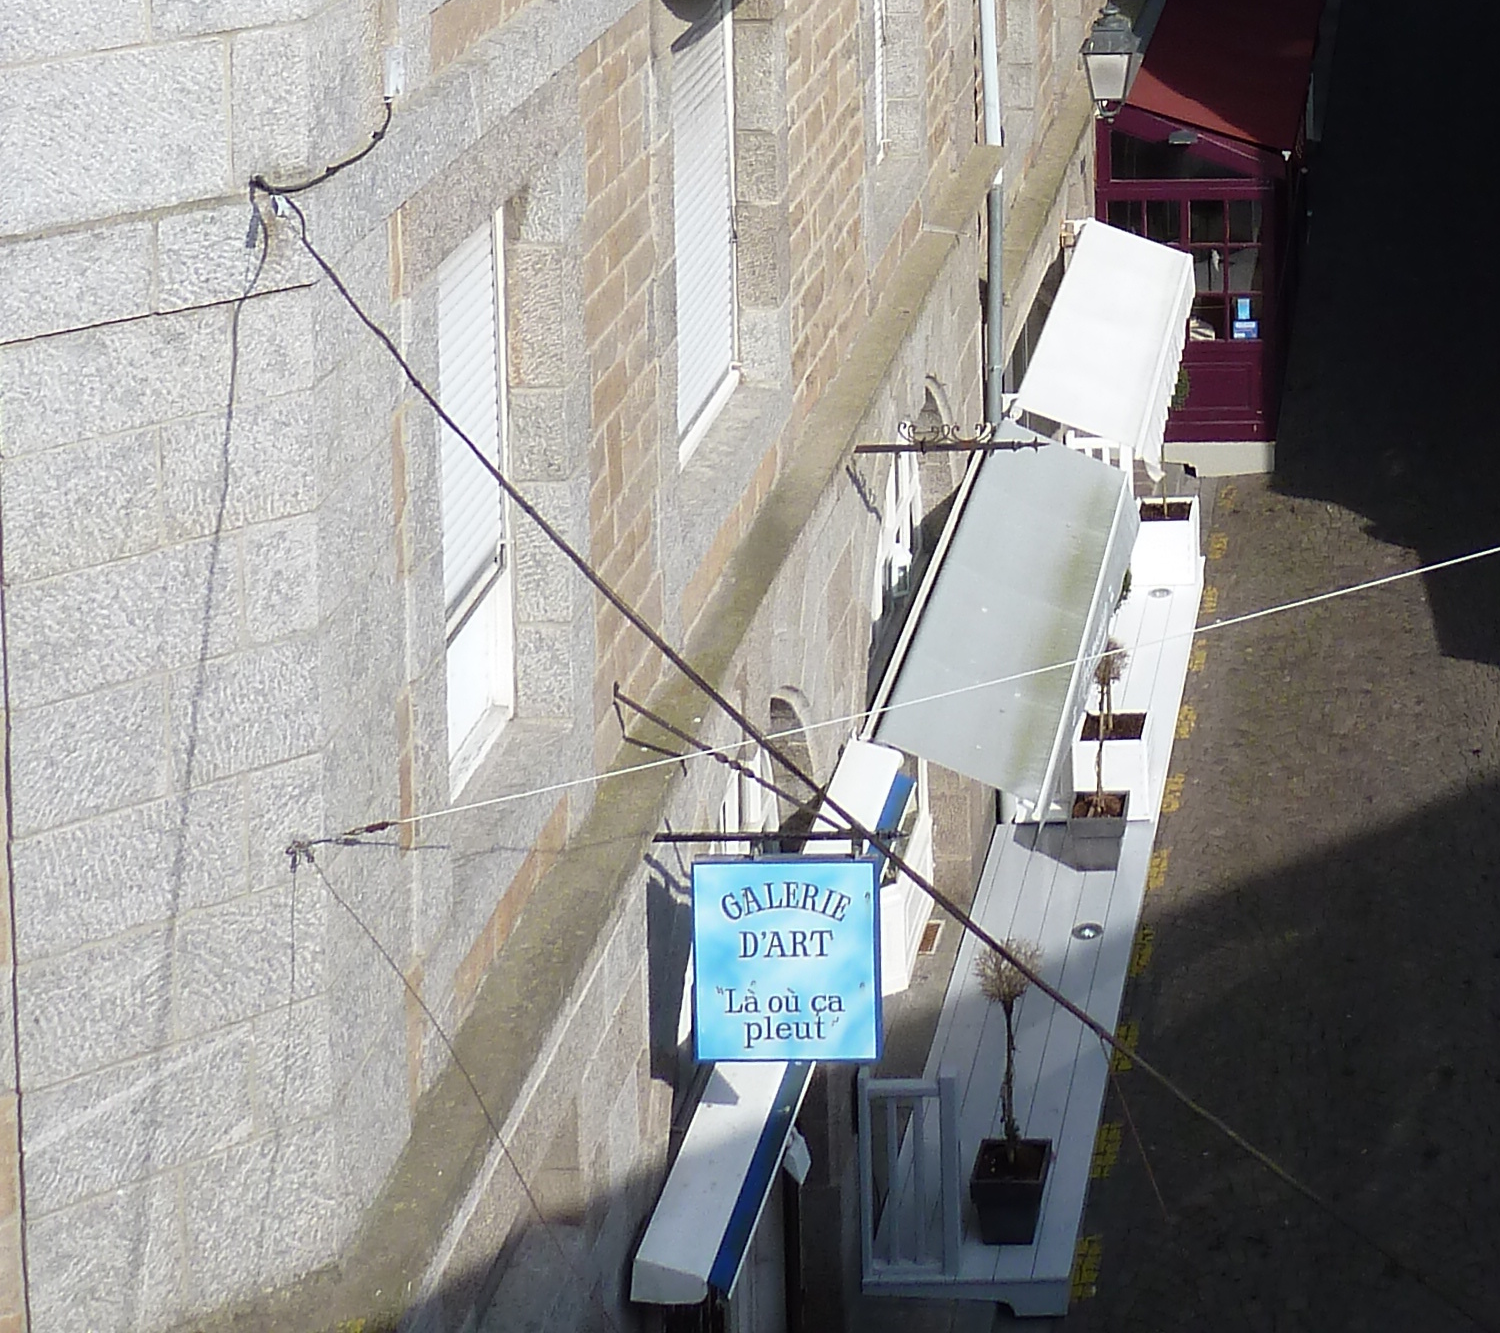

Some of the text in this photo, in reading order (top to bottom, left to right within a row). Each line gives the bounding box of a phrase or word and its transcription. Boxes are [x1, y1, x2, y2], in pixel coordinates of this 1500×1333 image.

[721, 881, 851, 922] GALERIE
[738, 930, 834, 958] D'ART
[768, 988, 801, 1014] où
[811, 993, 845, 1016] ça
